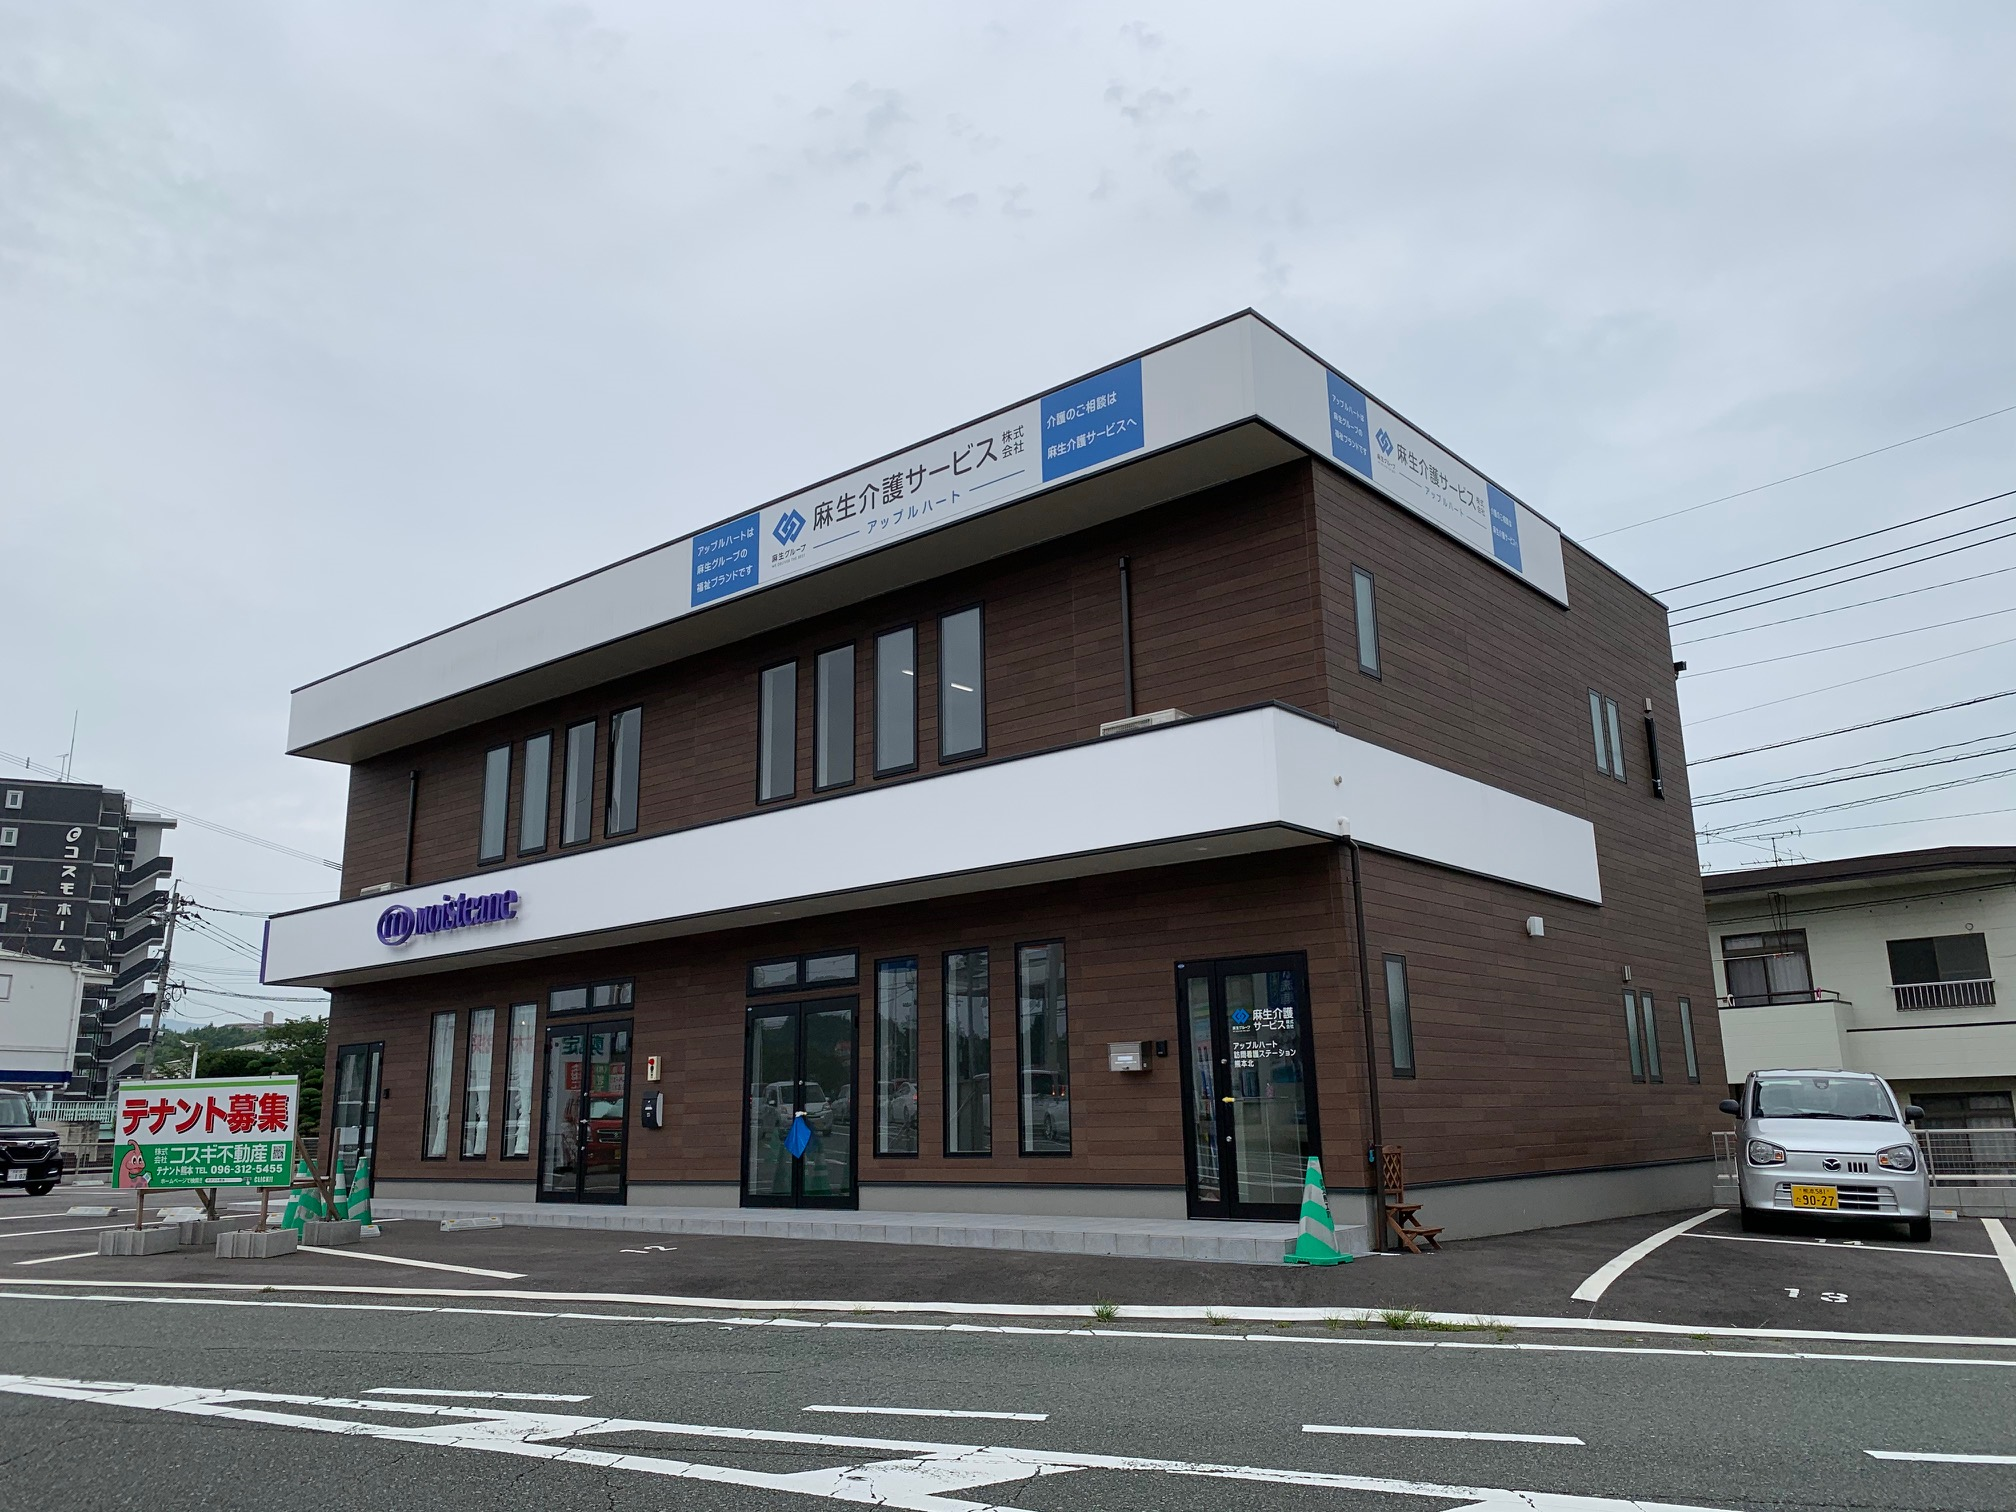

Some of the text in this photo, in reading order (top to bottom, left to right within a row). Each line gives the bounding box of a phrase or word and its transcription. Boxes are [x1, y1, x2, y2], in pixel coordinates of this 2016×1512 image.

[1047, 391, 1117, 429] 介護のご相談は
[1001, 425, 1024, 445] 株式
[1047, 418, 1137, 460] 麻生介護サービスへ
[1001, 440, 1024, 459] 会社
[813, 437, 998, 531] 麻生介護サービス
[1396, 443, 1476, 511] 麻生介護サービス
[867, 490, 960, 534] アップルハート
[697, 527, 755, 556] アップルハートは
[771, 544, 807, 563] 麻生グループ
[696, 548, 748, 575] 麻生グループの
[696, 565, 753, 593] 福祉ブランドです
[52, 845, 80, 952] コスモホーム
[1252, 1006, 1294, 1021] 麻生介護
[1253, 1020, 1286, 1031] サービス
[1233, 1040, 1278, 1050] アップルハート
[122, 1092, 290, 1136] テナント募集
[169, 1143, 268, 1164] コスギ不動産
[156, 1163, 283, 1176] テナント熊本 TEL 096-312-5455
[1802, 1194, 1835, 1207] 90-27
